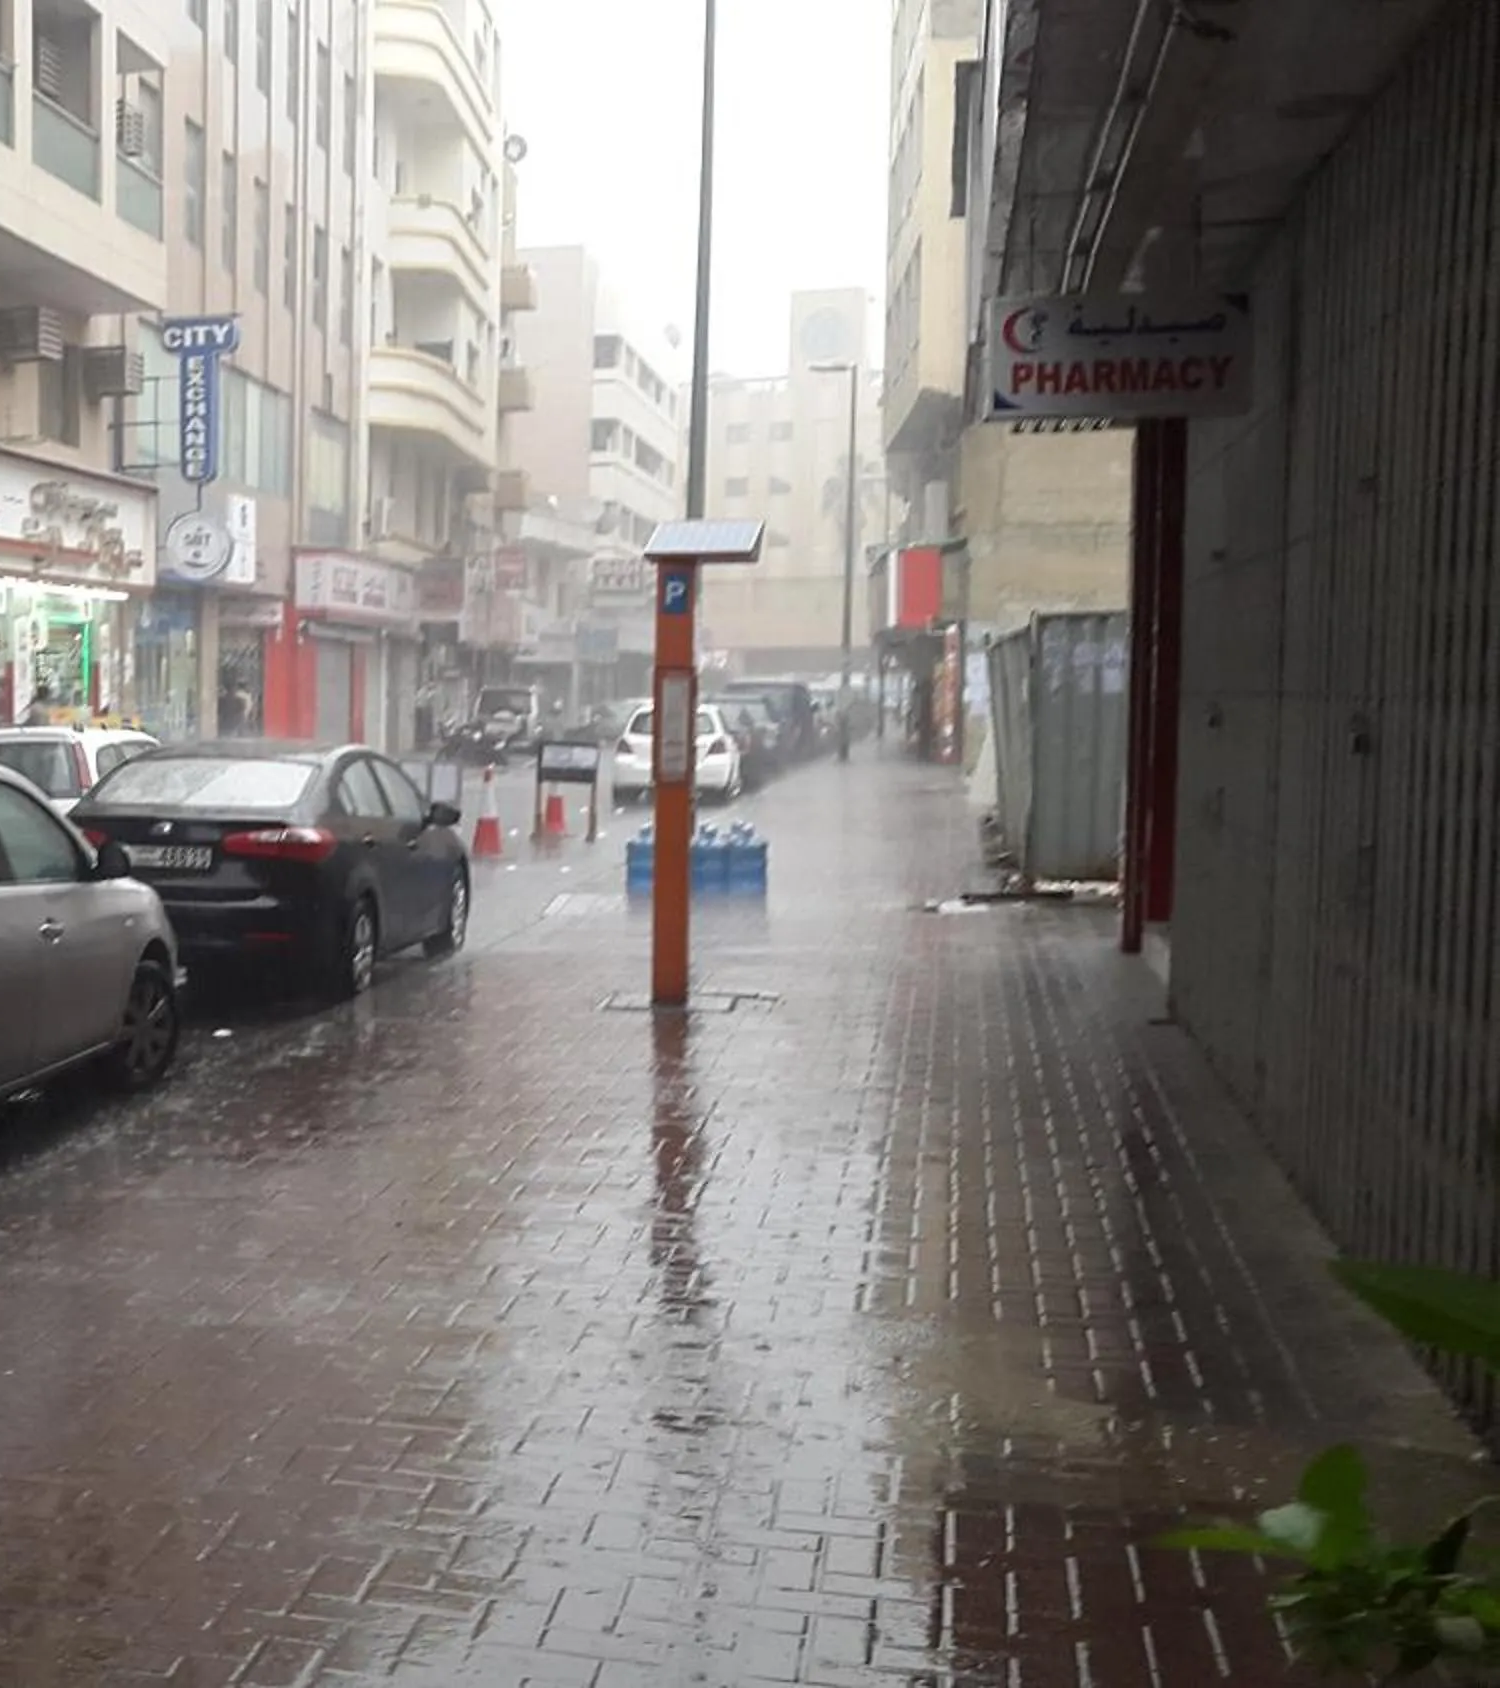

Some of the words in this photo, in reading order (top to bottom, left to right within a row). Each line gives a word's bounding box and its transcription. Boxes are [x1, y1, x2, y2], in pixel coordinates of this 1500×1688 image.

[163, 323, 231, 349] CITY
[1067, 303, 1227, 346] صيدلية
[1011, 355, 1234, 396] PHARMACY
[184, 354, 208, 479] EXCHANGE
[665, 580, 685, 606] P
